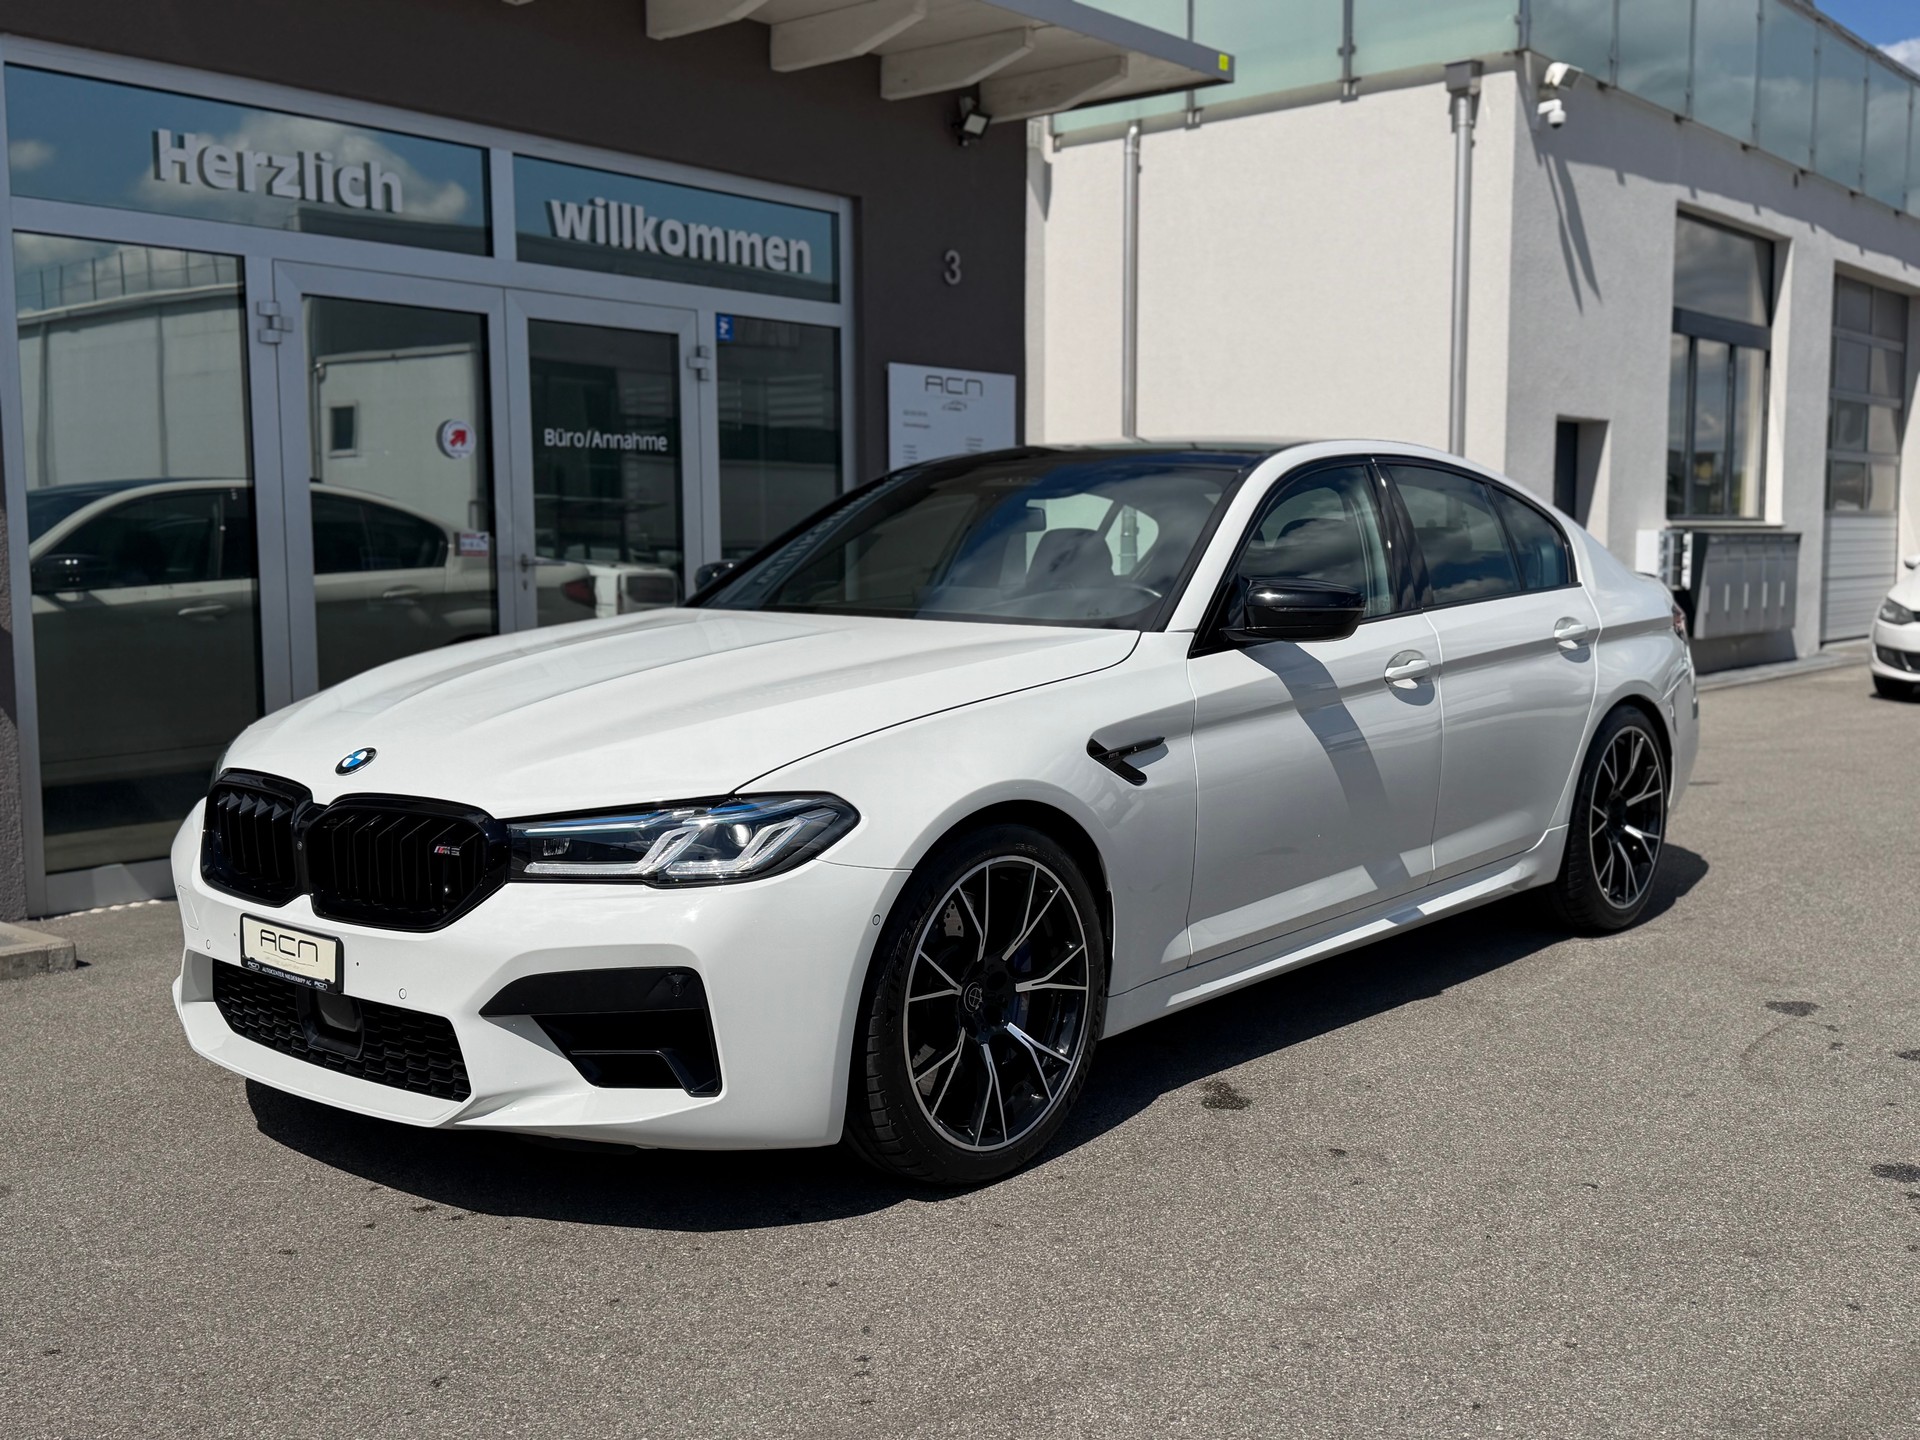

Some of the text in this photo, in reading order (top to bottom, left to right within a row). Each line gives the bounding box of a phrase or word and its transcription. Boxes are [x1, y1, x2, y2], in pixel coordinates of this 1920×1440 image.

[152, 129, 812, 274] Herzlich willkommen
[944, 249, 962, 286] 3
[543, 427, 668, 452] Büro/Annahme
[260, 929, 318, 962] ACN
